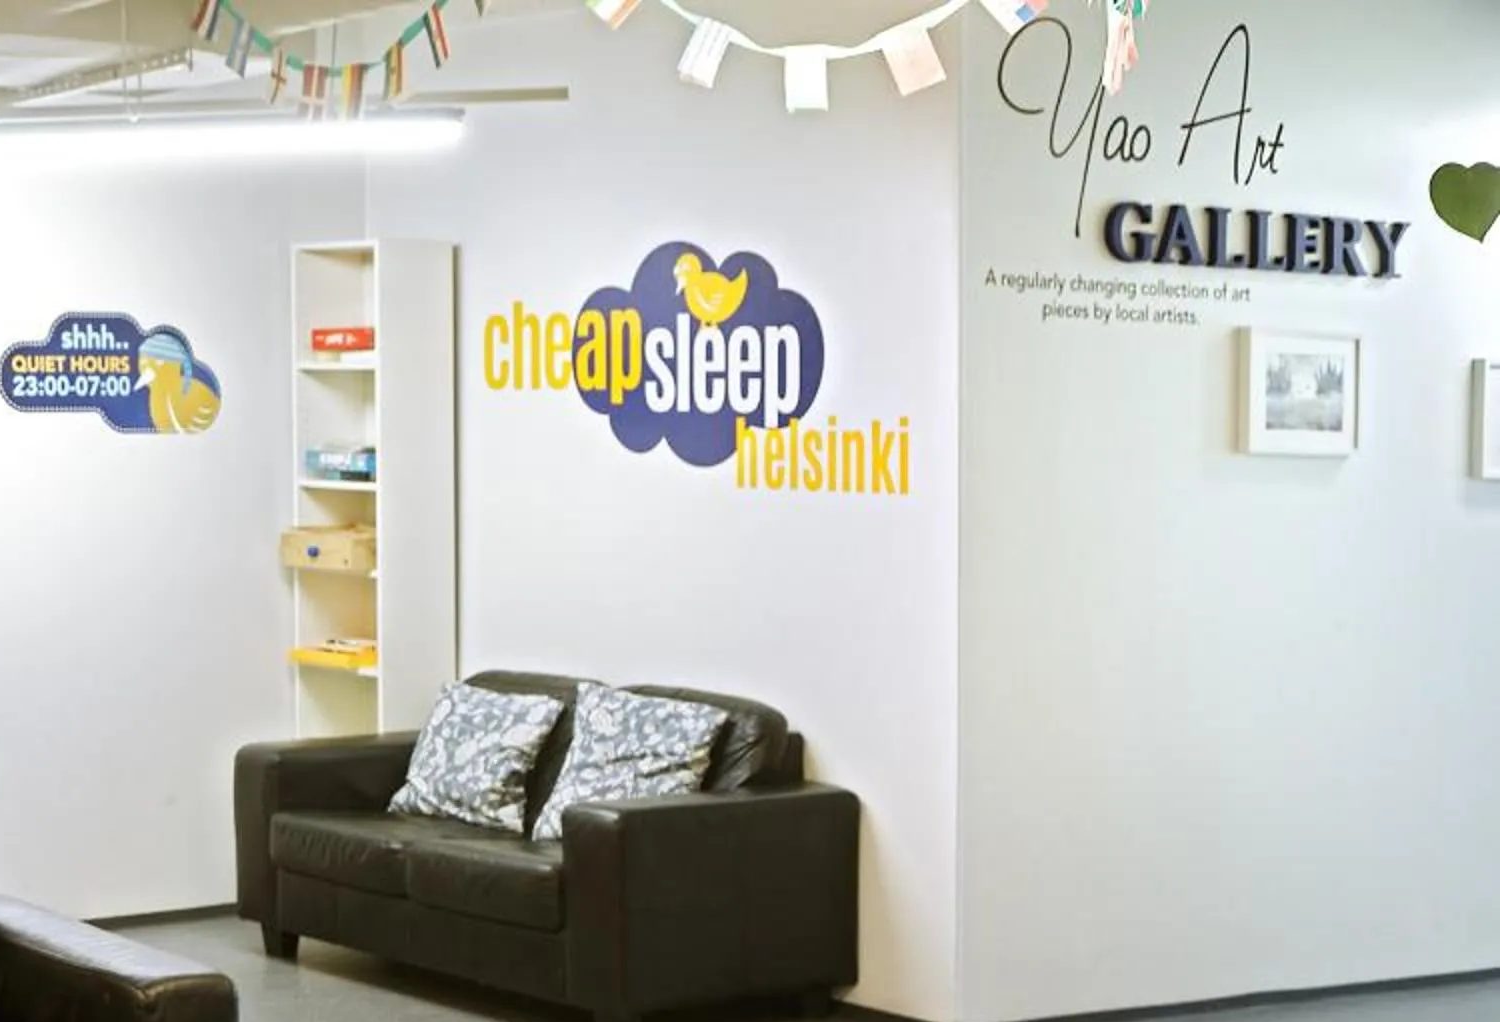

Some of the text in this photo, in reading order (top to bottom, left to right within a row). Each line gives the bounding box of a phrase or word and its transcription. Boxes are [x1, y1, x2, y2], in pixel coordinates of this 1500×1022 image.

[1177, 23, 1285, 186] Art
[1102, 200, 1411, 281] GALLERY
[984, 268, 1251, 302] A regularly changing collection of art
[1042, 302, 1090, 322] pieces
[1093, 303, 1113, 323] by
[1115, 303, 1150, 322] local
[10, 354, 131, 375] QUIET HOURS
[12, 374, 131, 398] 23:00-07:00
[735, 415, 910, 496] helsinki
